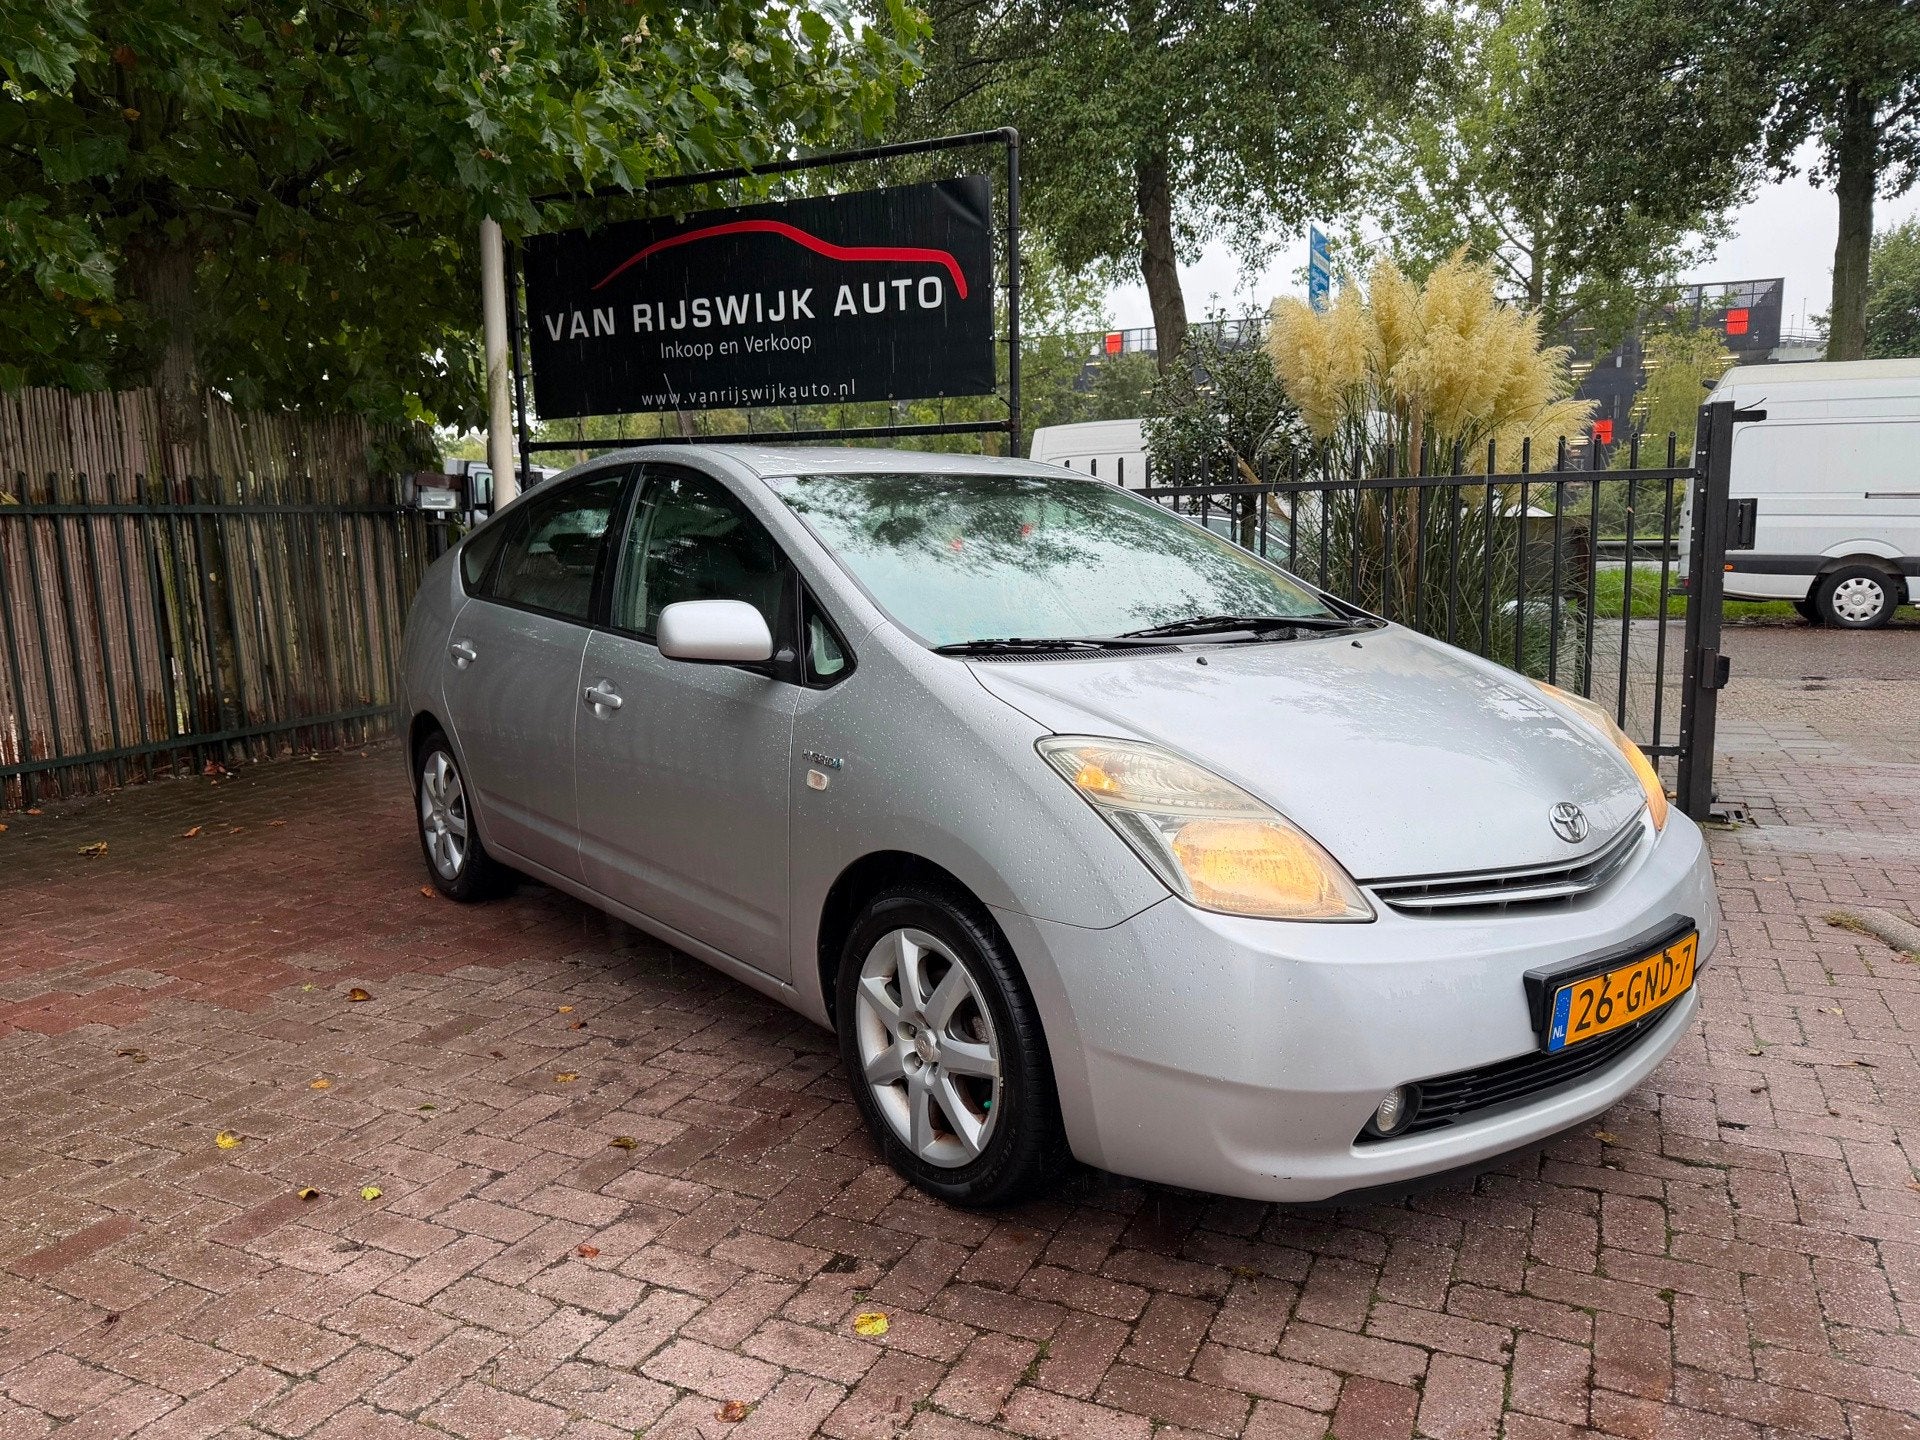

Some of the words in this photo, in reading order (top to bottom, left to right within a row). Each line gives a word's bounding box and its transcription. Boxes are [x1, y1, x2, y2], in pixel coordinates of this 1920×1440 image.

[544, 306, 616, 341] VAN
[633, 287, 816, 333] RIJSWIJK
[833, 275, 943, 317] AUTO
[660, 341, 714, 361] Inkoop
[719, 341, 739, 355] en
[744, 334, 812, 354] Verkoop
[641, 379, 856, 405] www.vanrijswijkauto.nl
[1575, 944, 1692, 1031] 26-GND-7
[1552, 1025, 1565, 1040] NL
